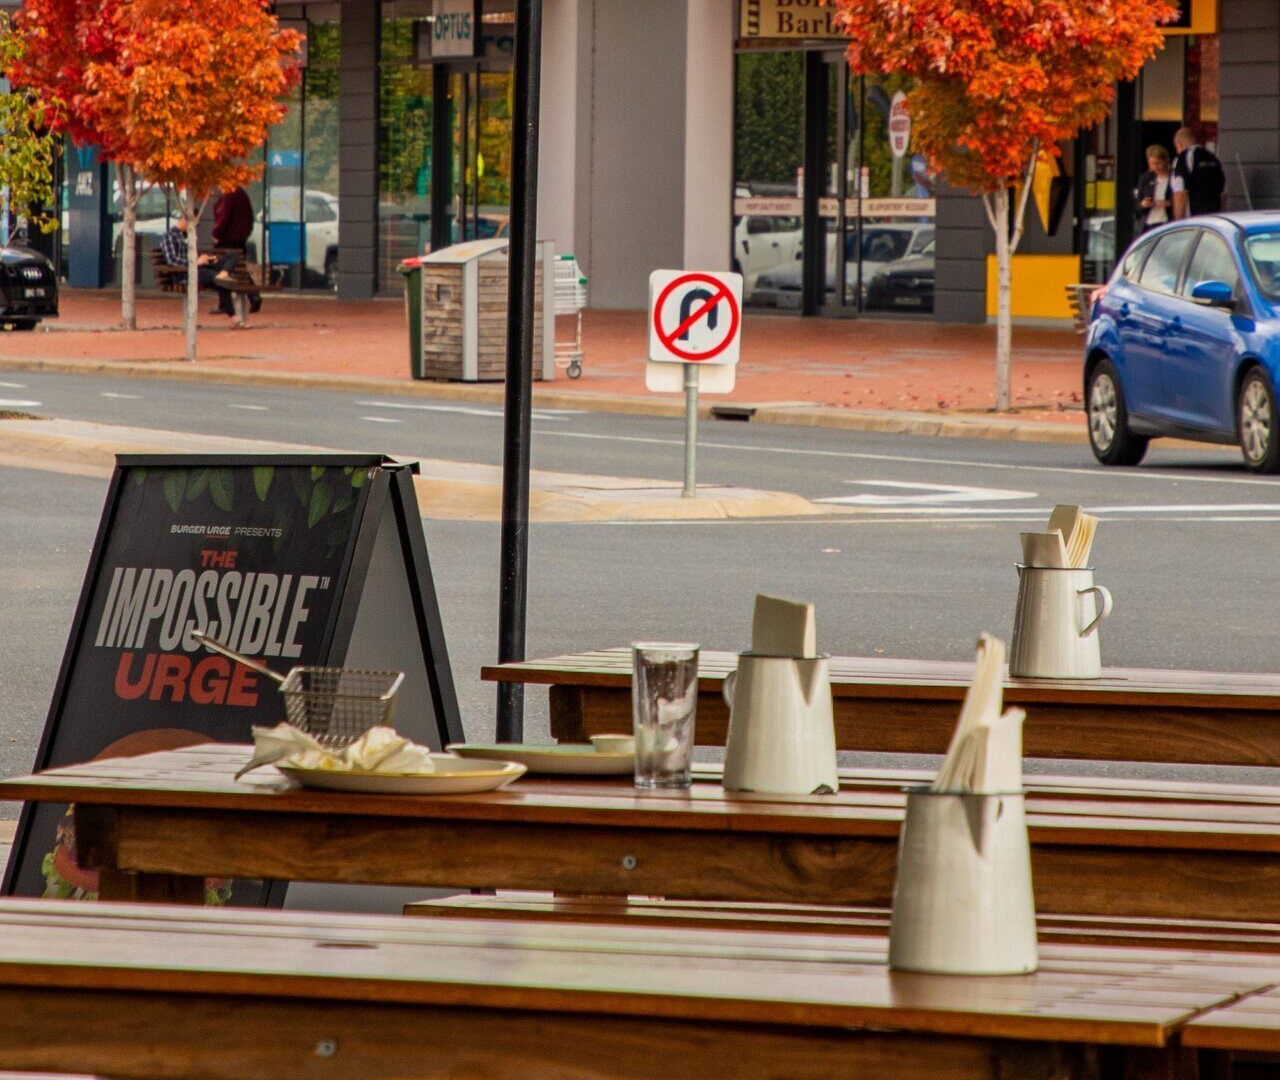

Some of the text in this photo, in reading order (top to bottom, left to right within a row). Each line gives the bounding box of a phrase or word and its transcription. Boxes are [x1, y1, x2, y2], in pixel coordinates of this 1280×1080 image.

[435, 11, 471, 39] OPTUS
[170, 524, 283, 538] BURGER URGE PRESENTS
[200, 549, 238, 569] THE
[94, 567, 320, 659] IMPOSSIBLE
[113, 651, 268, 708] URGE
